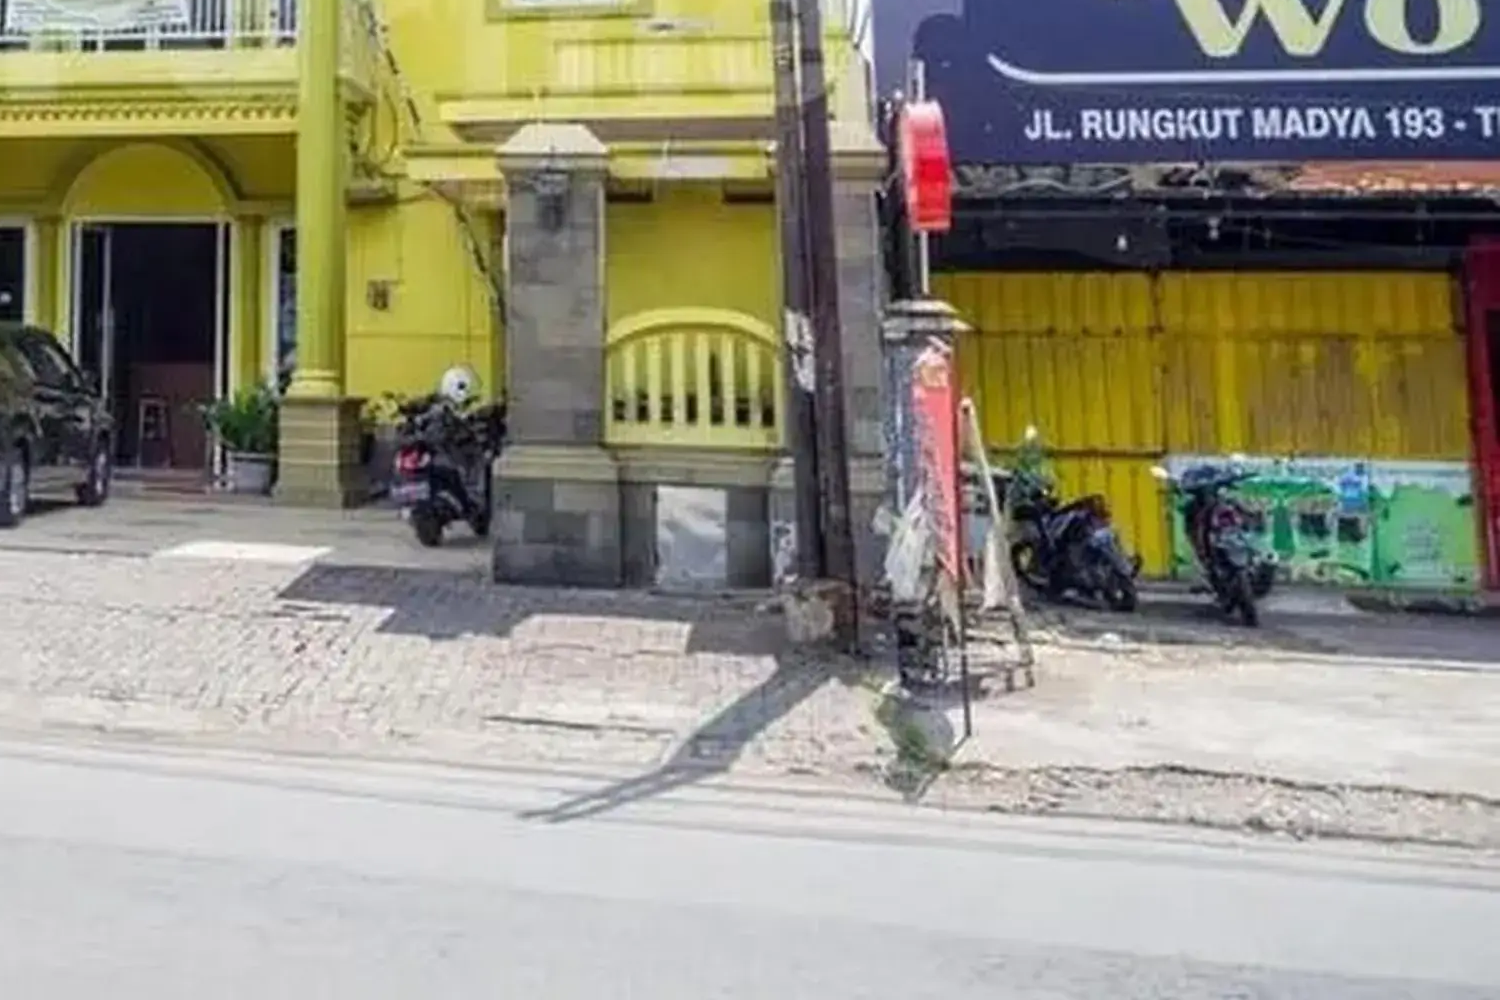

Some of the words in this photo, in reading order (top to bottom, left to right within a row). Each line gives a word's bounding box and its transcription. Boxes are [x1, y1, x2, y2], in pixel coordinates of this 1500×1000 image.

[1023, 108, 1072, 140] JL.
[1081, 107, 1243, 140] RUNGKUT
[1251, 106, 1376, 139] MADYA
[1385, 106, 1445, 139] 193
[1474, 106, 1500, 138] T
